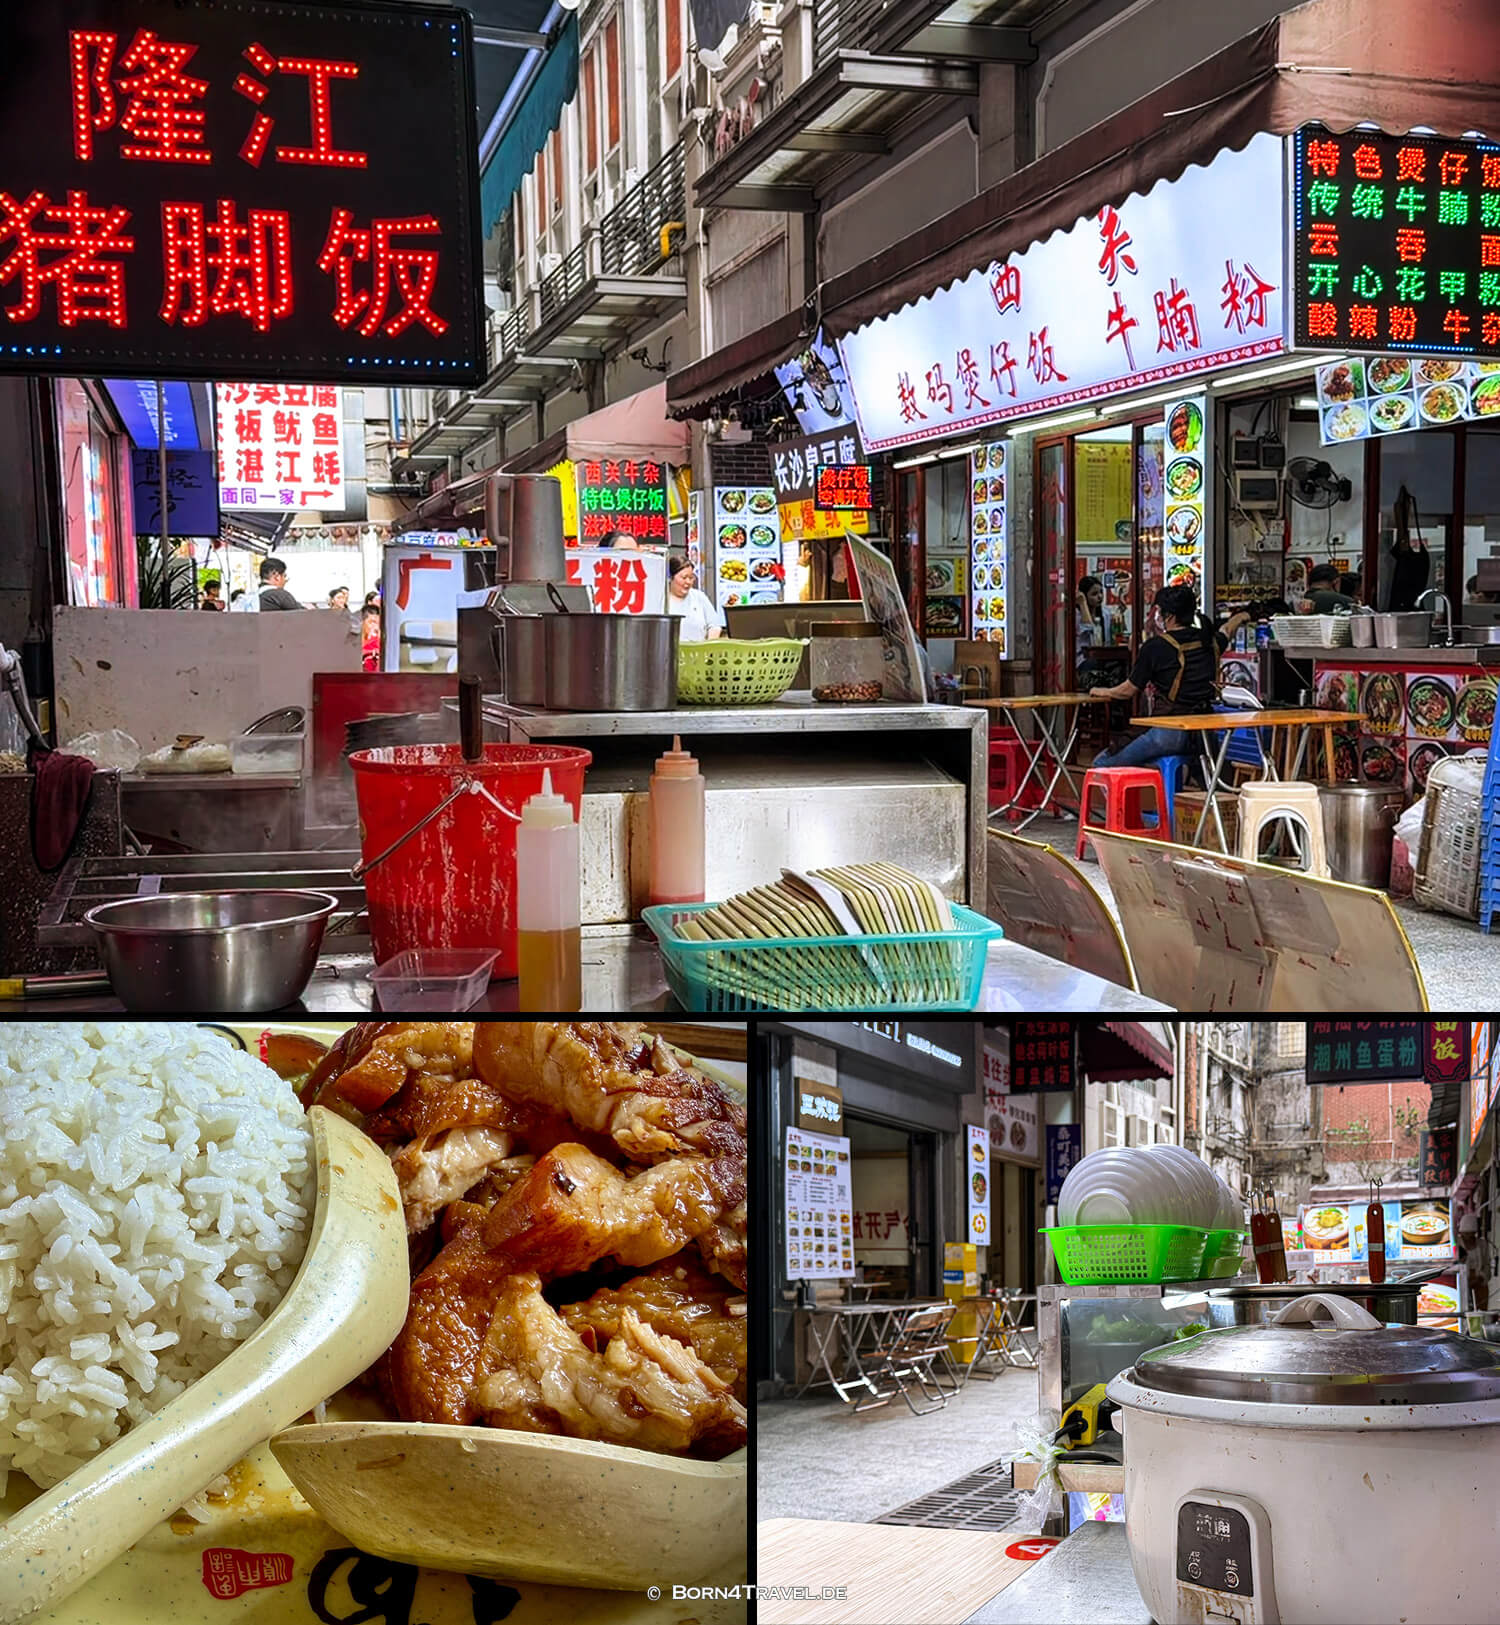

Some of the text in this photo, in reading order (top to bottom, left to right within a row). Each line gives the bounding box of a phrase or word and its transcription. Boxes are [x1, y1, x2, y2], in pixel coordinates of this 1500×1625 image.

[70, 28, 369, 168] 隆江
[0, 190, 450, 337] 猪脚饭
[896, 258, 1278, 425] 数码煲仔饭 牛腩粉
[218, 408, 339, 445] 板鱿鱼
[581, 487, 664, 511] 特色煲仔饭
[1313, 1035, 1417, 1072] 潮州鱼蛋粉
